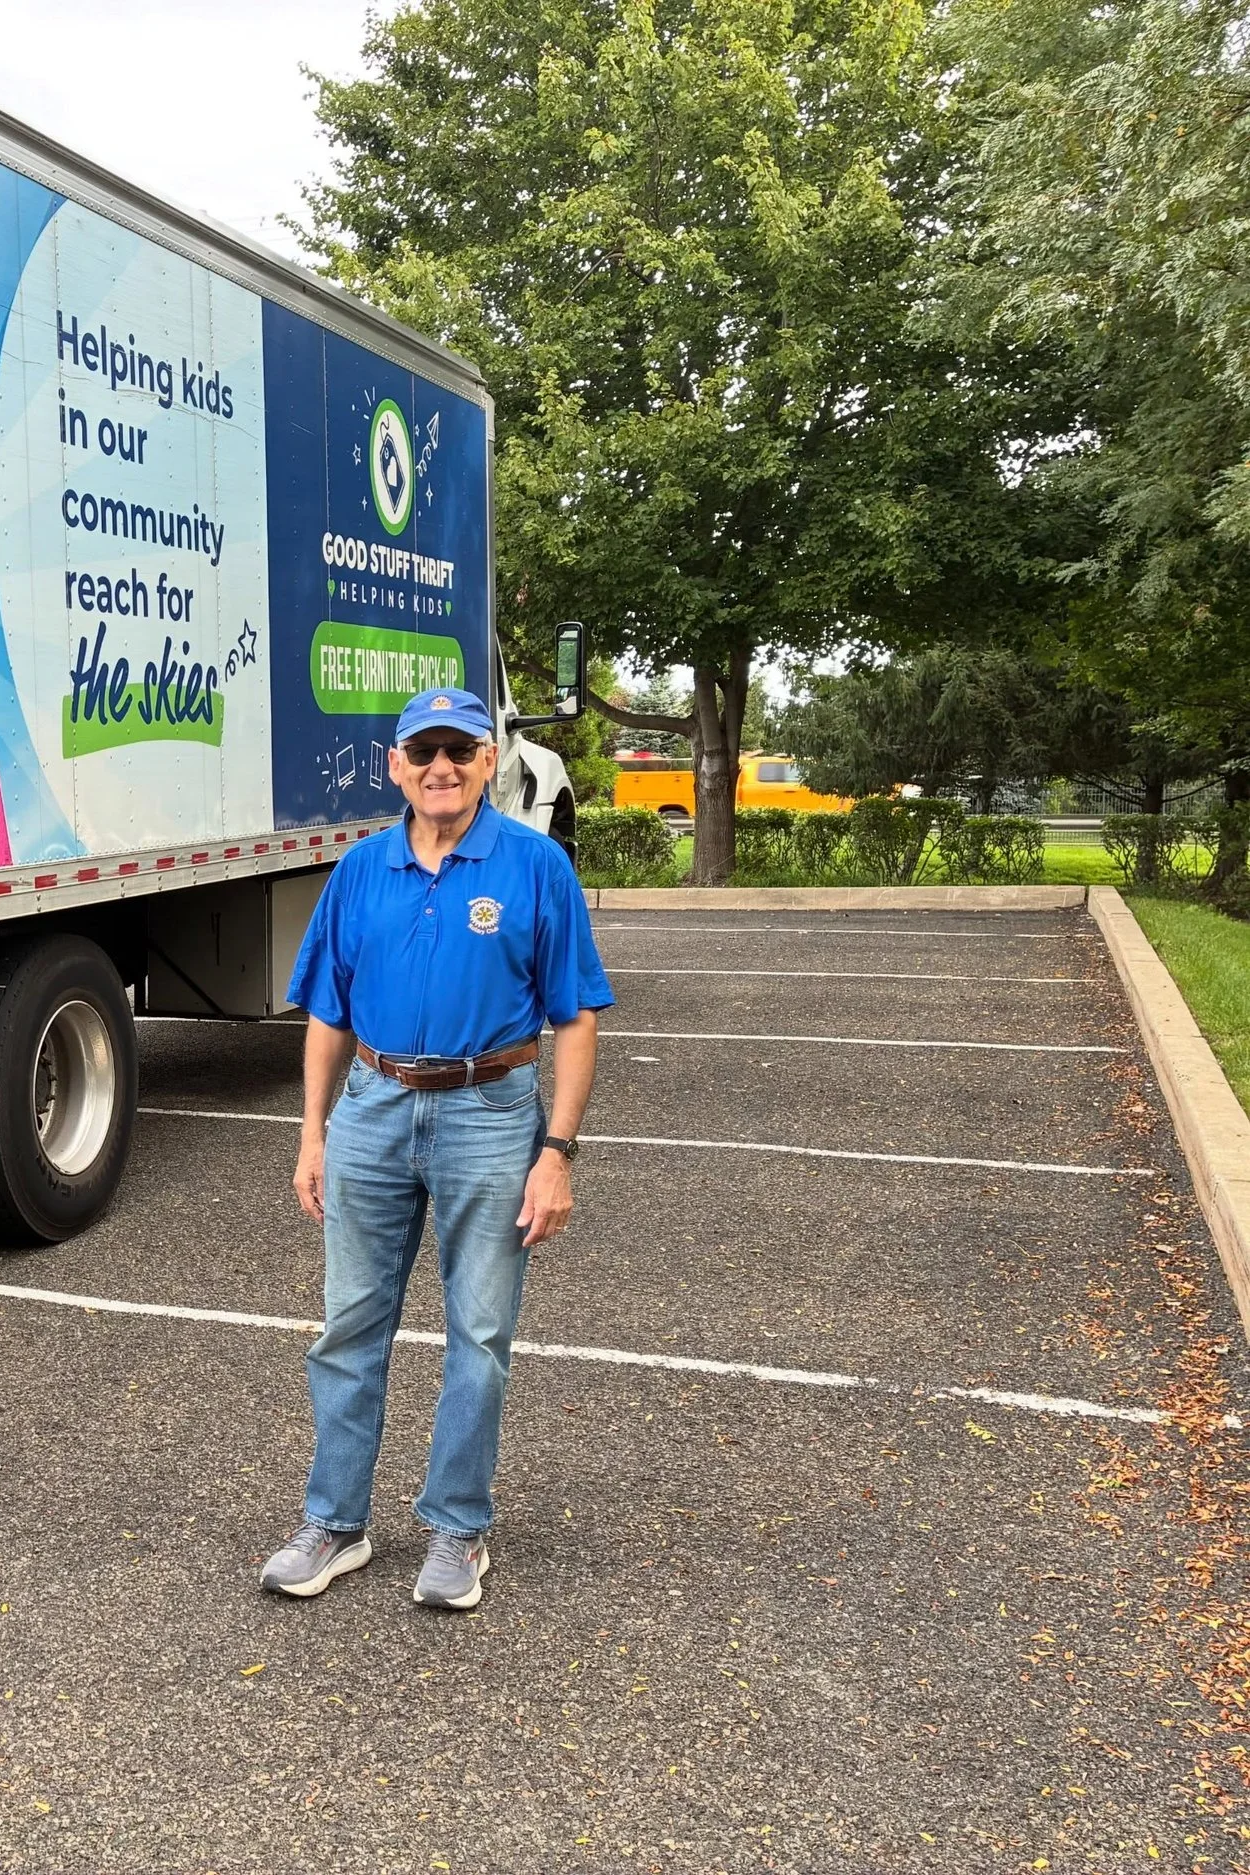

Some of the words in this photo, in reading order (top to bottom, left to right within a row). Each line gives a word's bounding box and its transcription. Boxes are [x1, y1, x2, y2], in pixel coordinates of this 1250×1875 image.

[56, 310, 173, 409] Helping
[182, 357, 234, 419] kids
[58, 387, 88, 449] in
[98, 418, 148, 464] our
[61, 488, 225, 567] community
[322, 532, 368, 571] GOOD
[370, 543, 410, 580] STUFF
[412, 553, 455, 589] THRIFT
[64, 568, 149, 617] reach
[157, 572, 194, 622] for
[340, 581, 405, 610] HELPING
[413, 594, 443, 616] KIDS
[70, 620, 133, 725] the
[137, 636, 217, 725] skies
[320, 644, 353, 691] FREE
[354, 648, 417, 694] FURNITURE
[418, 654, 458, 691] PICK-UP
